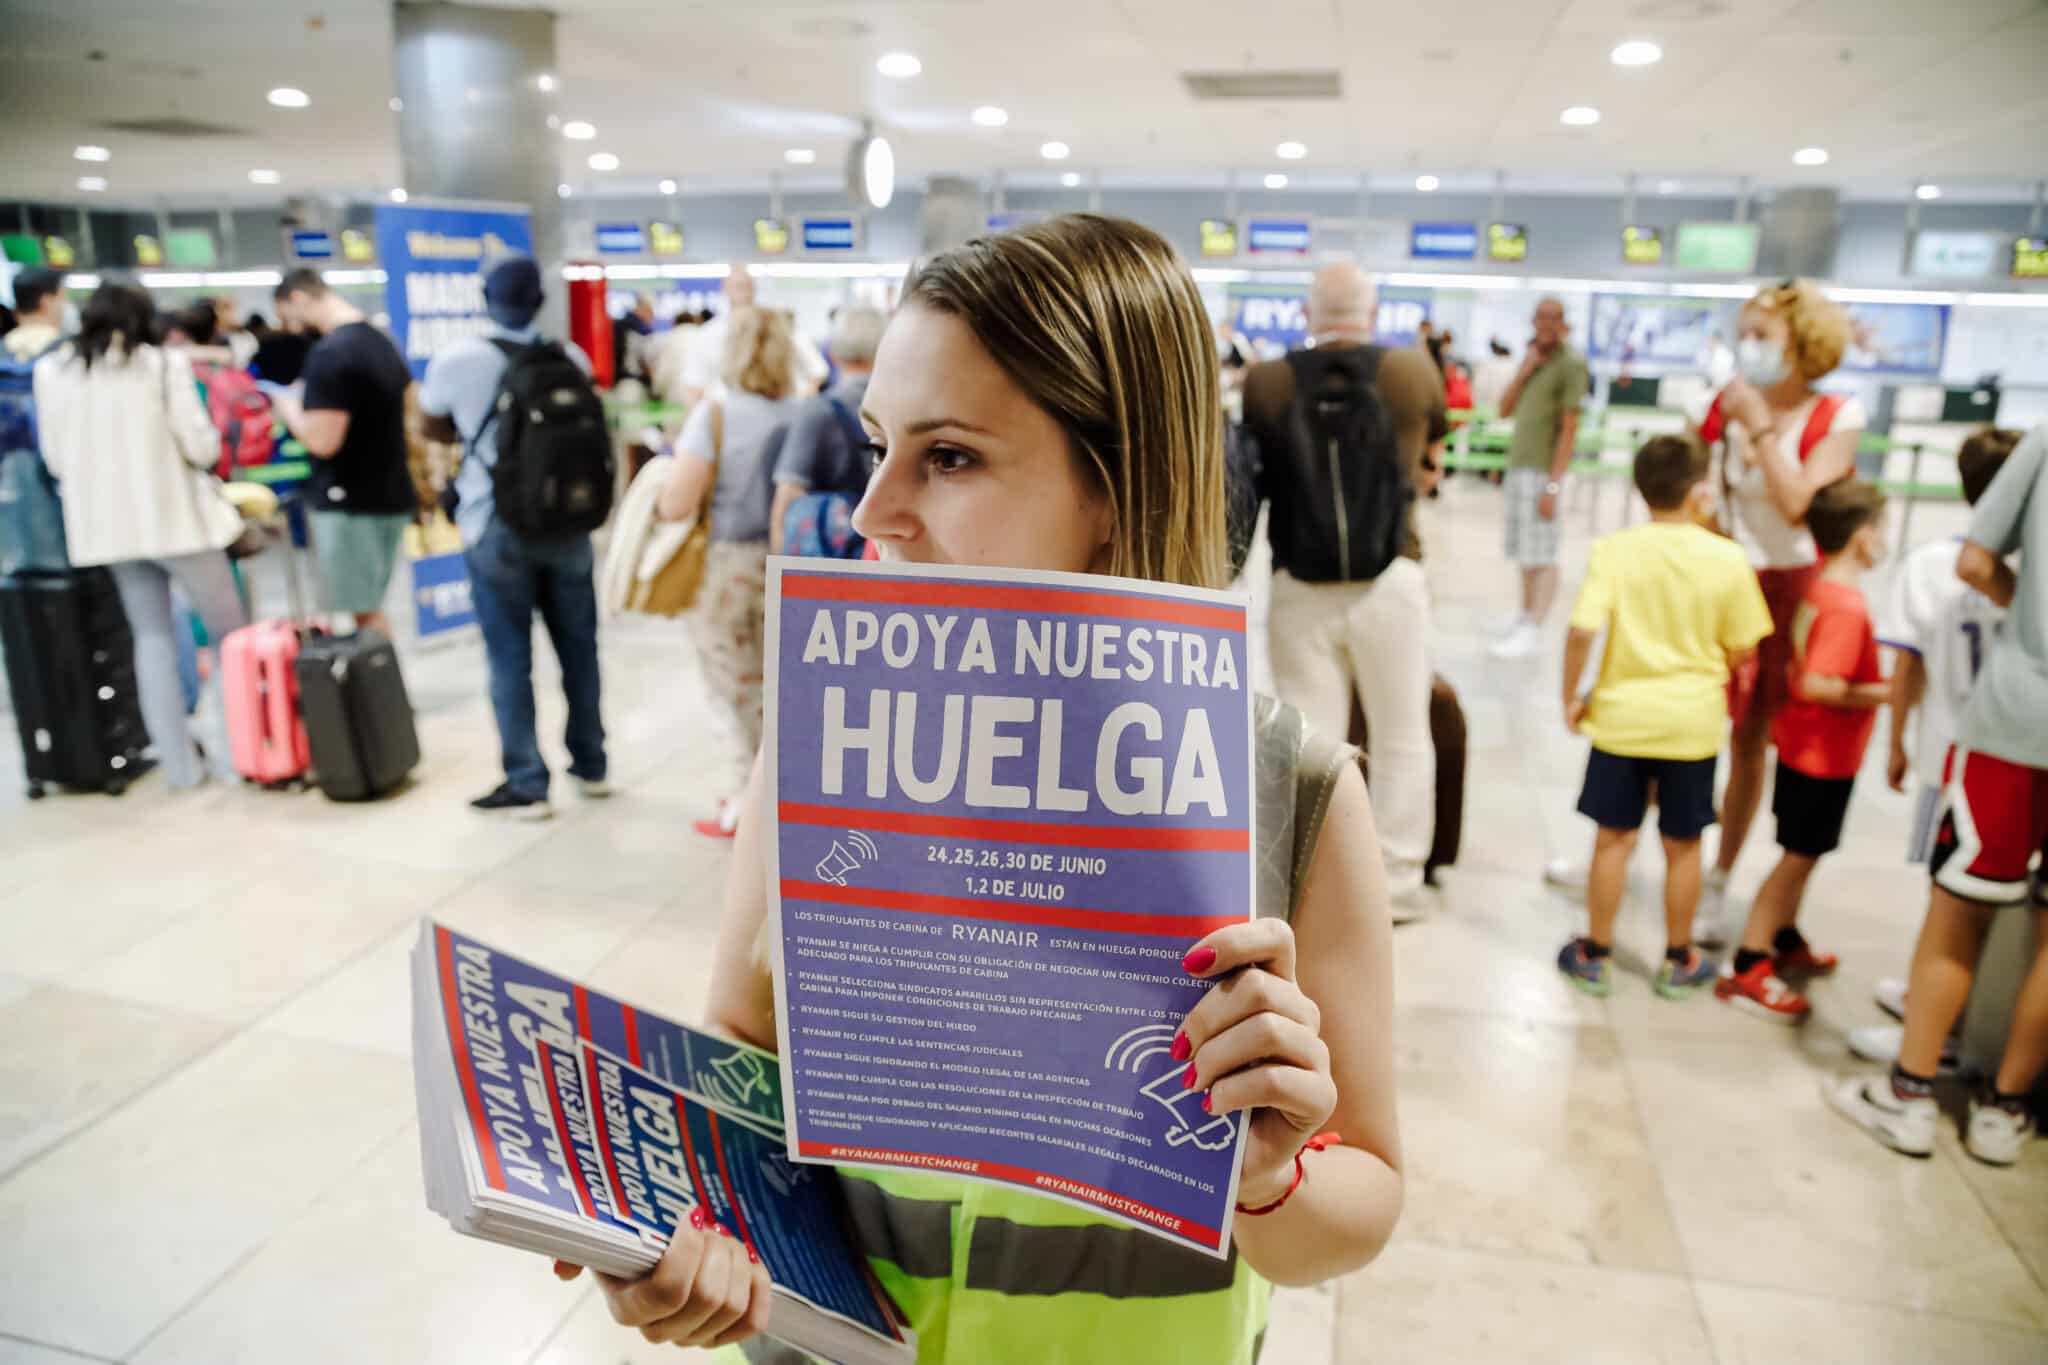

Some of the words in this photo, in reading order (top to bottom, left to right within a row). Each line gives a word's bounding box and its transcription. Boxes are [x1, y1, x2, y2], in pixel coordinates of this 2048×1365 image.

[803, 609, 996, 674] APOYA
[1014, 619, 1239, 691] NUESTRA
[821, 686, 1227, 817] HUELGA
[928, 846, 1026, 870] 24,25,26,30
[1030, 854, 1053, 872] DE
[1058, 856, 1107, 875] JUNIO
[965, 878, 987, 894] 1,2
[993, 880, 1015, 897] DE
[1020, 883, 1064, 900] JULIO
[795, 912, 812, 920] LOS
[815, 913, 876, 928] TRIPULANTES
[878, 921, 891, 930] DE
[893, 922, 928, 934] CABINA
[931, 927, 943, 936] DE
[952, 924, 1039, 948] RYANAIR
[1050, 938, 1080, 951] ESTÁN
[1083, 942, 1096, 952] EN
[1098, 944, 1136, 957] HUELGA
[797, 936, 837, 948] RYANAIR
[839, 941, 850, 949] SE
[852, 943, 880, 953] NIEGA
[891, 947, 933, 959] CUMPLIR
[936, 952, 956, 961] CON
[957, 954, 972, 963] SU
[974, 956, 1032, 970] OBLIGACIÓN
[1035, 962, 1048, 972] DE
[1050, 964, 1099, 977] NEGOCIAR
[1102, 970, 1117, 978] UN
[1119, 971, 1170, 984] CONVENIO
[797, 948, 847, 961] ADECUADO
[849, 953, 873, 965] PARA
[875, 957, 892, 966] LOS
[894, 959, 957, 974] TRIPULANTES
[959, 967, 973, 975] DE
[974, 968, 1009, 979] CABINA
[455, 943, 514, 1083] NUESTRA
[799, 971, 839, 984] RYANAIR
[841, 976, 897, 990] SELECCIONA
[955, 989, 1007, 1003] AMARILLOS
[1009, 996, 1026, 1004] SIN
[1028, 997, 1113, 1014] REPRESENTACIÓN
[1115, 1006, 1147, 1017] ENTRE
[1149, 1010, 1166, 1020] LOS
[1169, 1012, 1184, 1021] TRI
[799, 983, 833, 994] CABINA
[835, 987, 858, 998] PARA
[906, 995, 971, 1011] CONDICIONES
[973, 1003, 985, 1012] DE
[988, 1004, 1027, 1016] TRABAJO
[1030, 1008, 1082, 1021] PRECARIAS
[800, 1004, 840, 1017] RYANAIR
[842, 1009, 869, 1020] SIGUE
[871, 1014, 884, 1022] SU
[927, 1020, 944, 1029] DEL
[802, 1027, 841, 1039] RYANAIR
[843, 1032, 856, 1041] NO
[859, 1034, 895, 1045] CUMPLE
[898, 1038, 914, 1047] LAS
[915, 1040, 971, 1053] SENTENCIAS
[597, 1058, 635, 1153] NUESTRA
[480, 1082, 551, 1194] APOYA
[832, 1147, 979, 1172] #RYANAIRMUSTCHANGE
[614, 1151, 658, 1224] APOYA
[1035, 1175, 1181, 1231] #RYANAIRMUSTCHANGE
